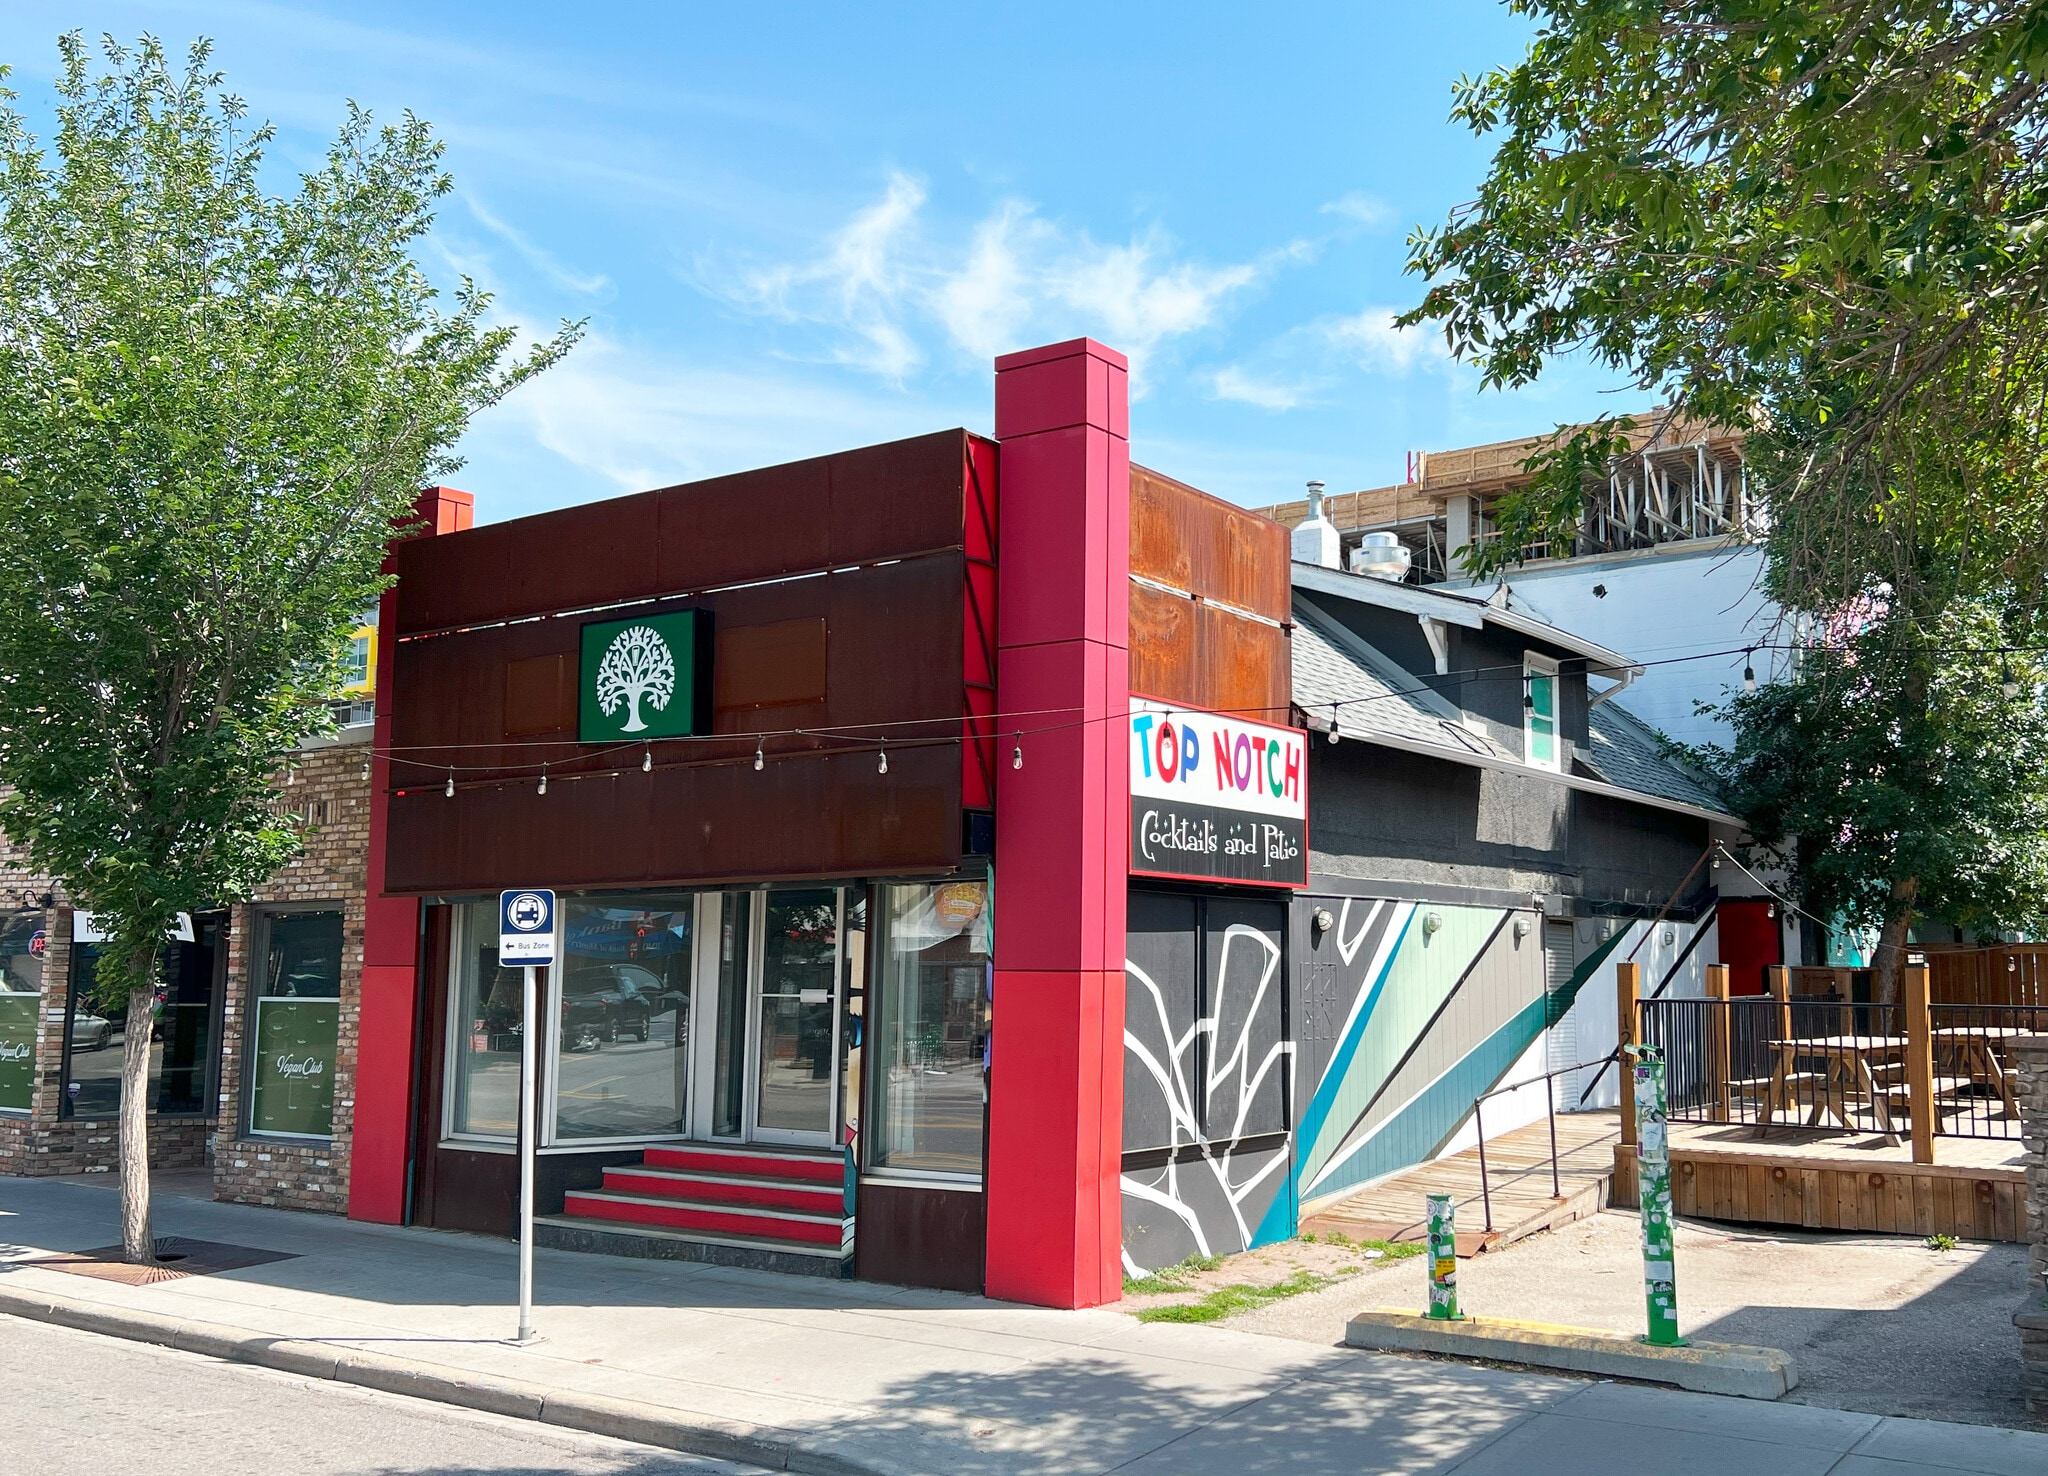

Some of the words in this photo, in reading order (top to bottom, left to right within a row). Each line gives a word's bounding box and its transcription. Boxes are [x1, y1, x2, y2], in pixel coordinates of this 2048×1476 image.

[1133, 715, 1200, 784] TOP
[1213, 729, 1300, 803] NOTCH
[1141, 810, 1218, 862] Cocktails
[1224, 823, 1257, 856] and
[1261, 824, 1298, 867] Patio
[277, 1054, 303, 1078] Vegan
[302, 1057, 323, 1075] Club
